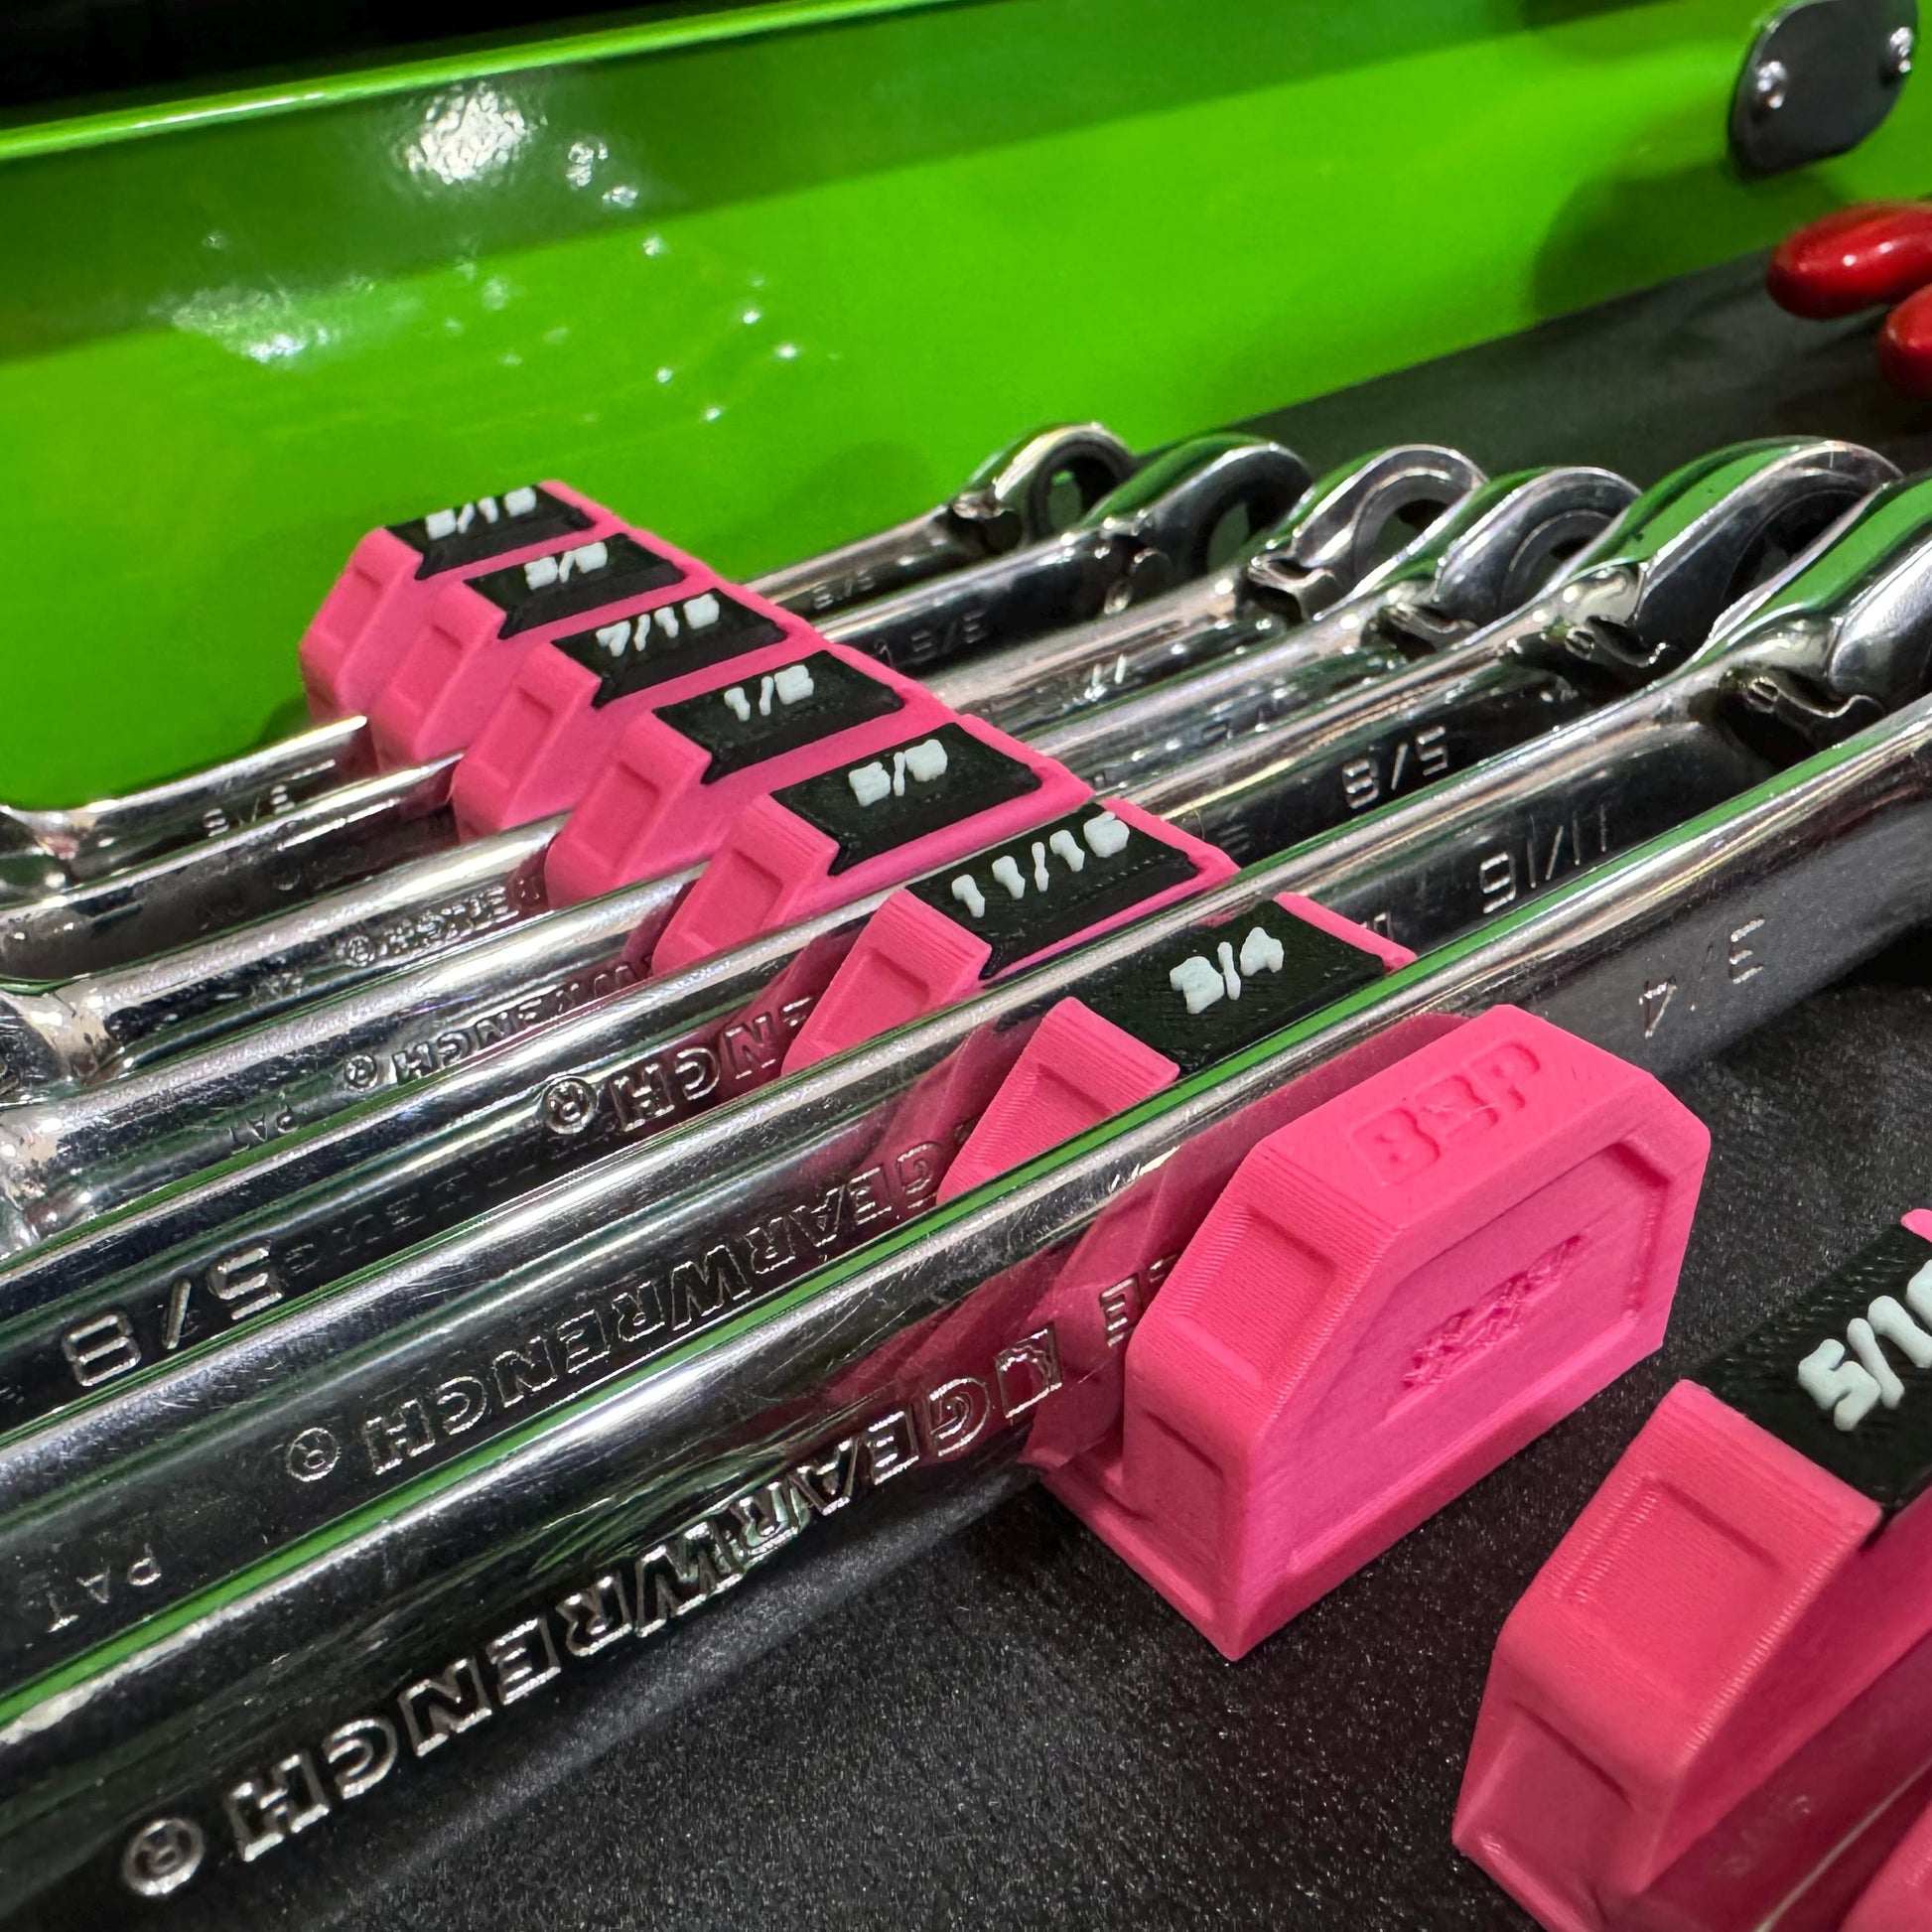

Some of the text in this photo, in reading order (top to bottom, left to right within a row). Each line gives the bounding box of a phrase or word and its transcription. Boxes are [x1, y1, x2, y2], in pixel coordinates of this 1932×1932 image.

[1341, 725, 1450, 810] 5/8
[950, 811, 1131, 918] 11/16
[1479, 802, 1607, 914] 11/16
[1169, 925, 1286, 1015] 3/4
[60, 1240, 285, 1387] 5/8
[366, 1141, 940, 1476] GEARWRENCH
[221, 1377, 991, 1863] GEARWRENCH
